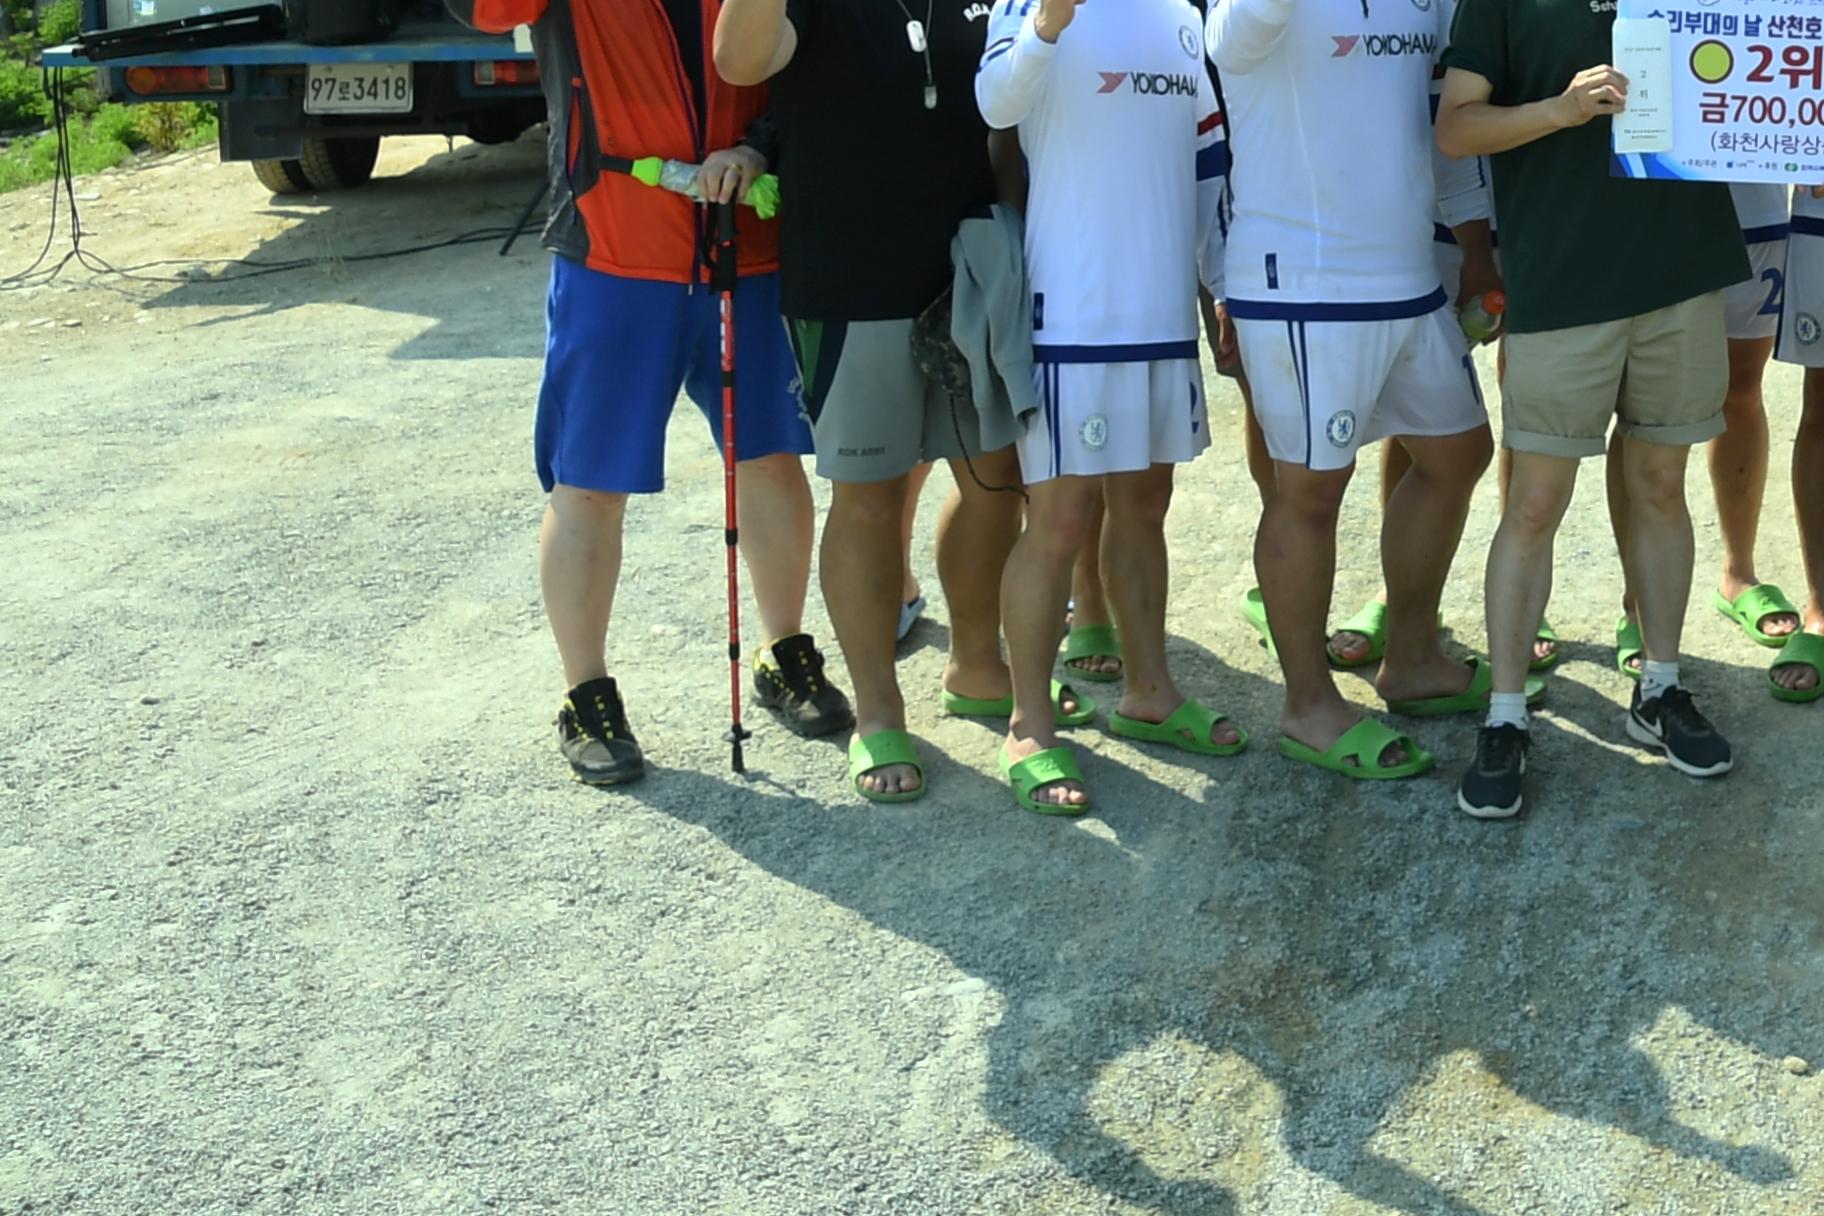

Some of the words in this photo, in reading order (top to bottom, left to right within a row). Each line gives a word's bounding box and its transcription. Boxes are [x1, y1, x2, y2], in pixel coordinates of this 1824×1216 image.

[1744, 14, 1763, 37] 날
[1767, 15, 1823, 40] 산천호
[1745, 43, 1824, 90] 2위
[310, 75, 407, 101] 97로3418
